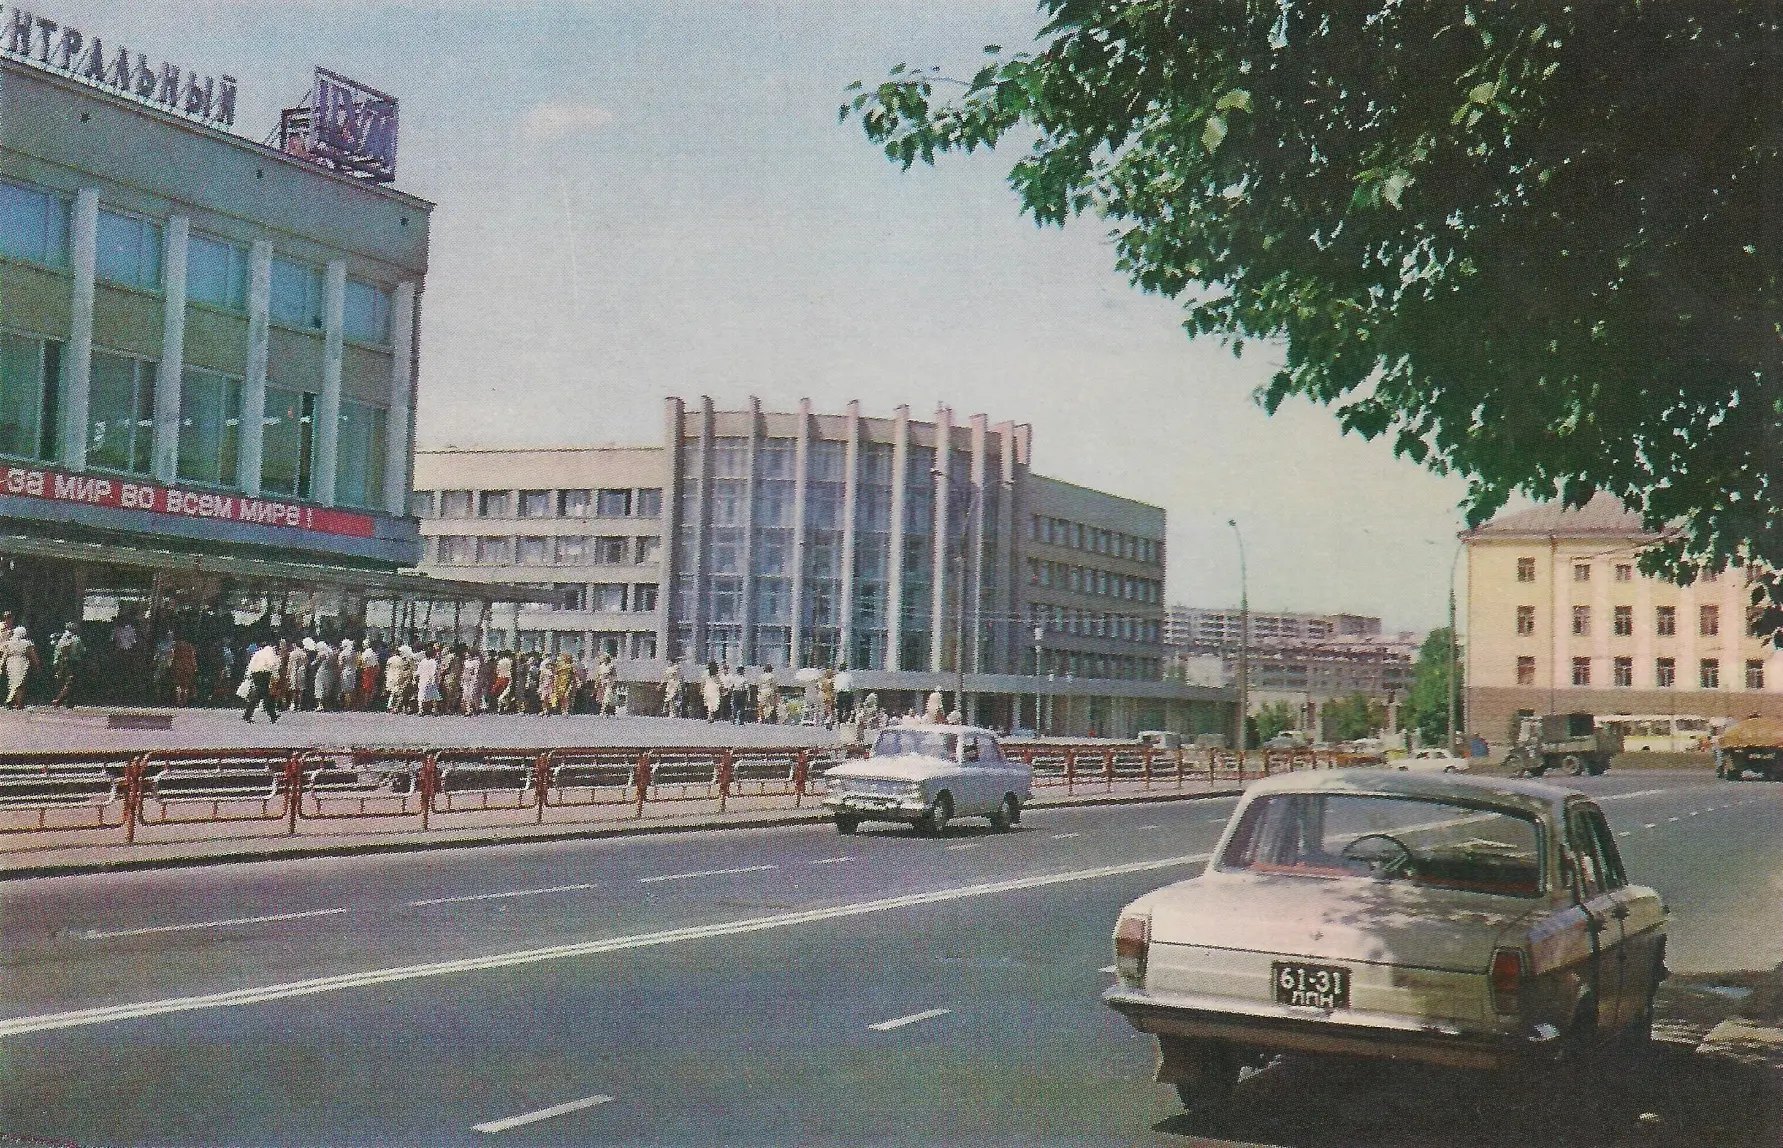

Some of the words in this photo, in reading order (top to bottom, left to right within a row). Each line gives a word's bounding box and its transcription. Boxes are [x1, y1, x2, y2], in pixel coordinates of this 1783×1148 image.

[0, 4, 237, 126] НТРАЛЬНЫЙ
[121, 483, 155, 509] ВО
[1280, 967, 1342, 995] 61-31
